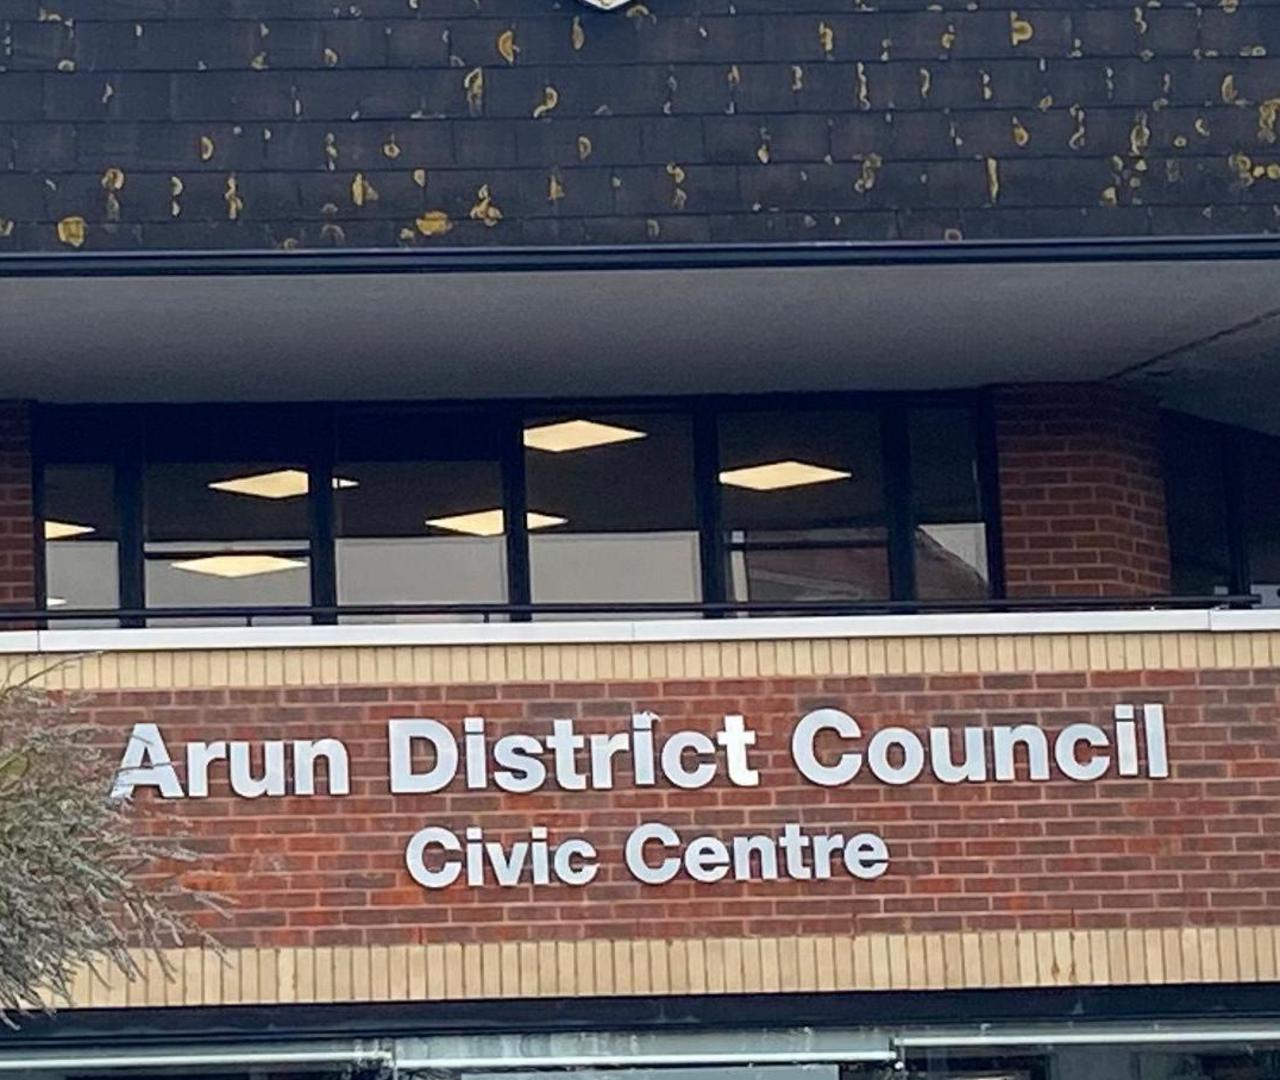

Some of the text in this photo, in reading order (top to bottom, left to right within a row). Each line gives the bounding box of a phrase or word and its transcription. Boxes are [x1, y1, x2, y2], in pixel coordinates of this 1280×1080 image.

[112, 702, 1170, 800] Arun District Council
[404, 822, 890, 890] Civic Centre
